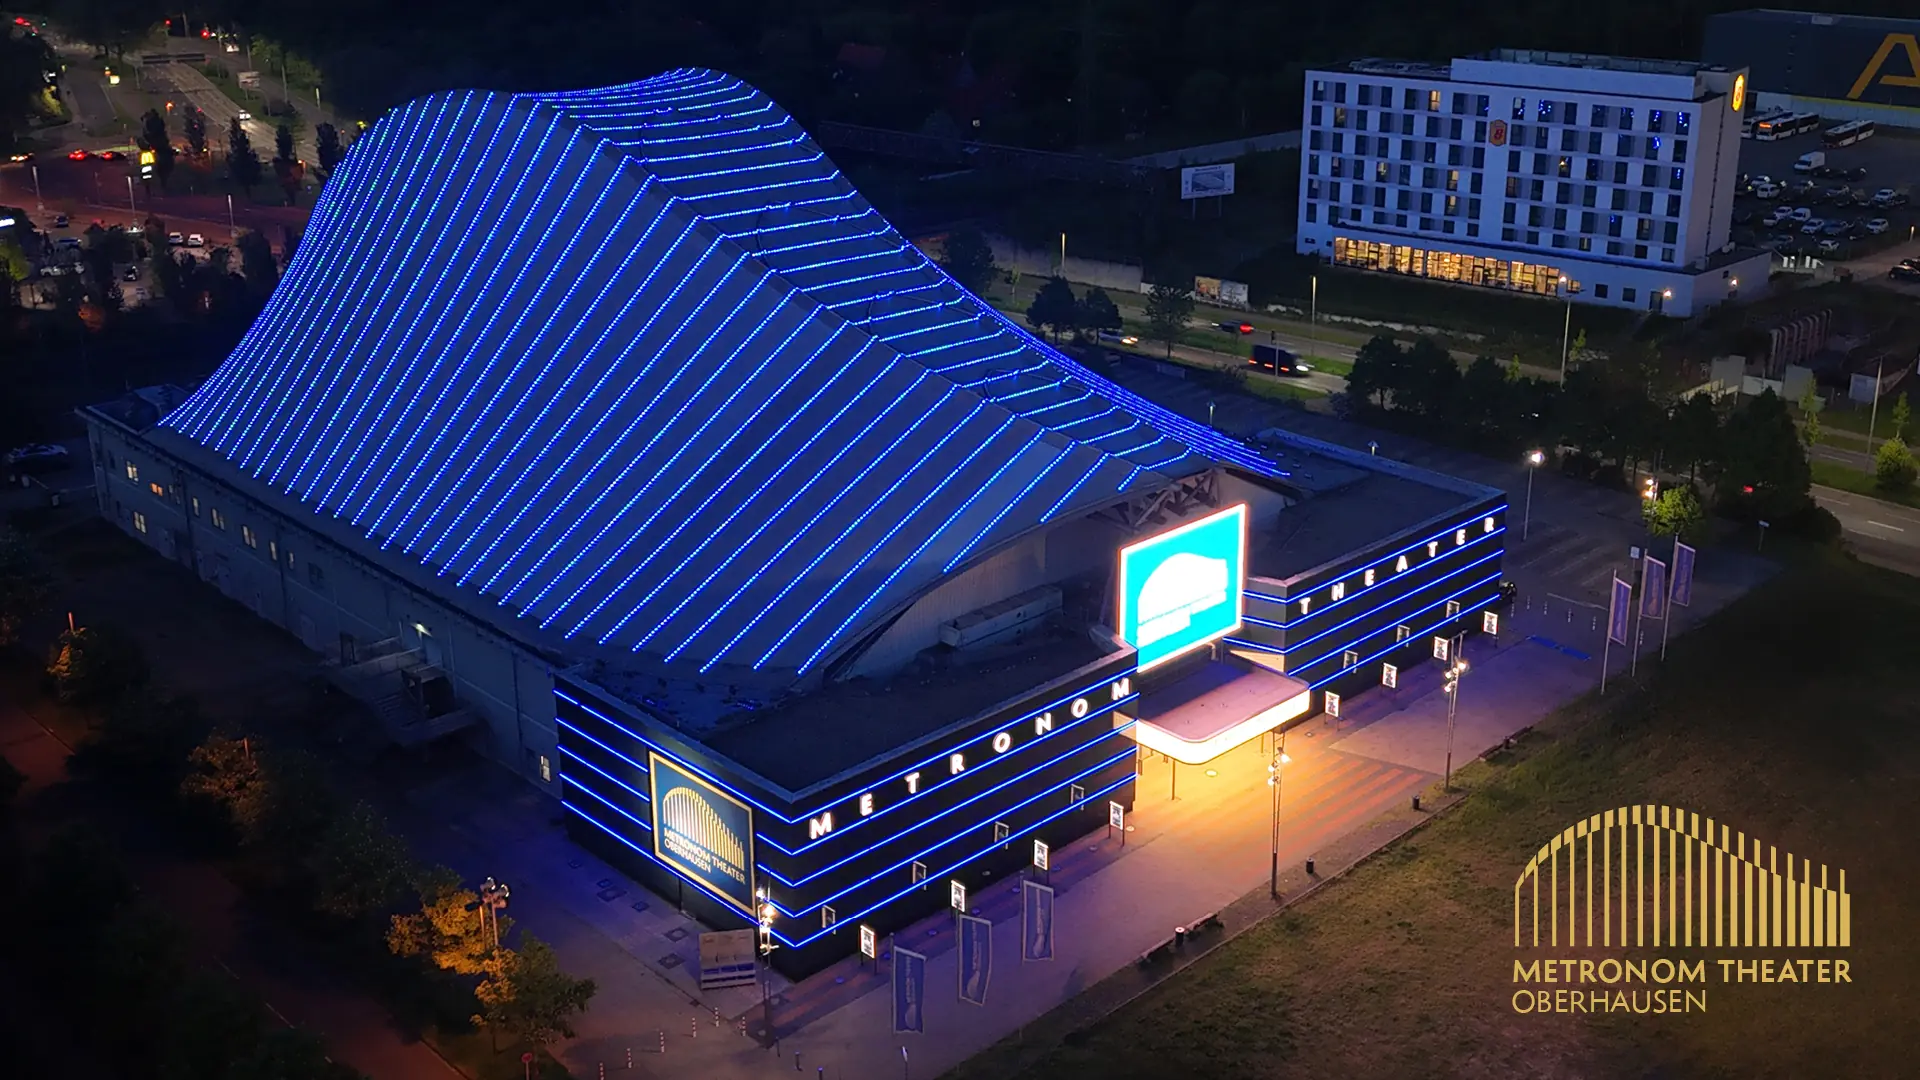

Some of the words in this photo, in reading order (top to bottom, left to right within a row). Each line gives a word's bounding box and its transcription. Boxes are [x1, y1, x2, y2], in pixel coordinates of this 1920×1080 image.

[1299, 517, 1494, 614] THEATER
[809, 678, 1130, 839] METRONOM
[664, 828, 711, 862] METRONOM
[712, 857, 746, 884] THEATER
[664, 839, 711, 873] OBERHAUSEN
